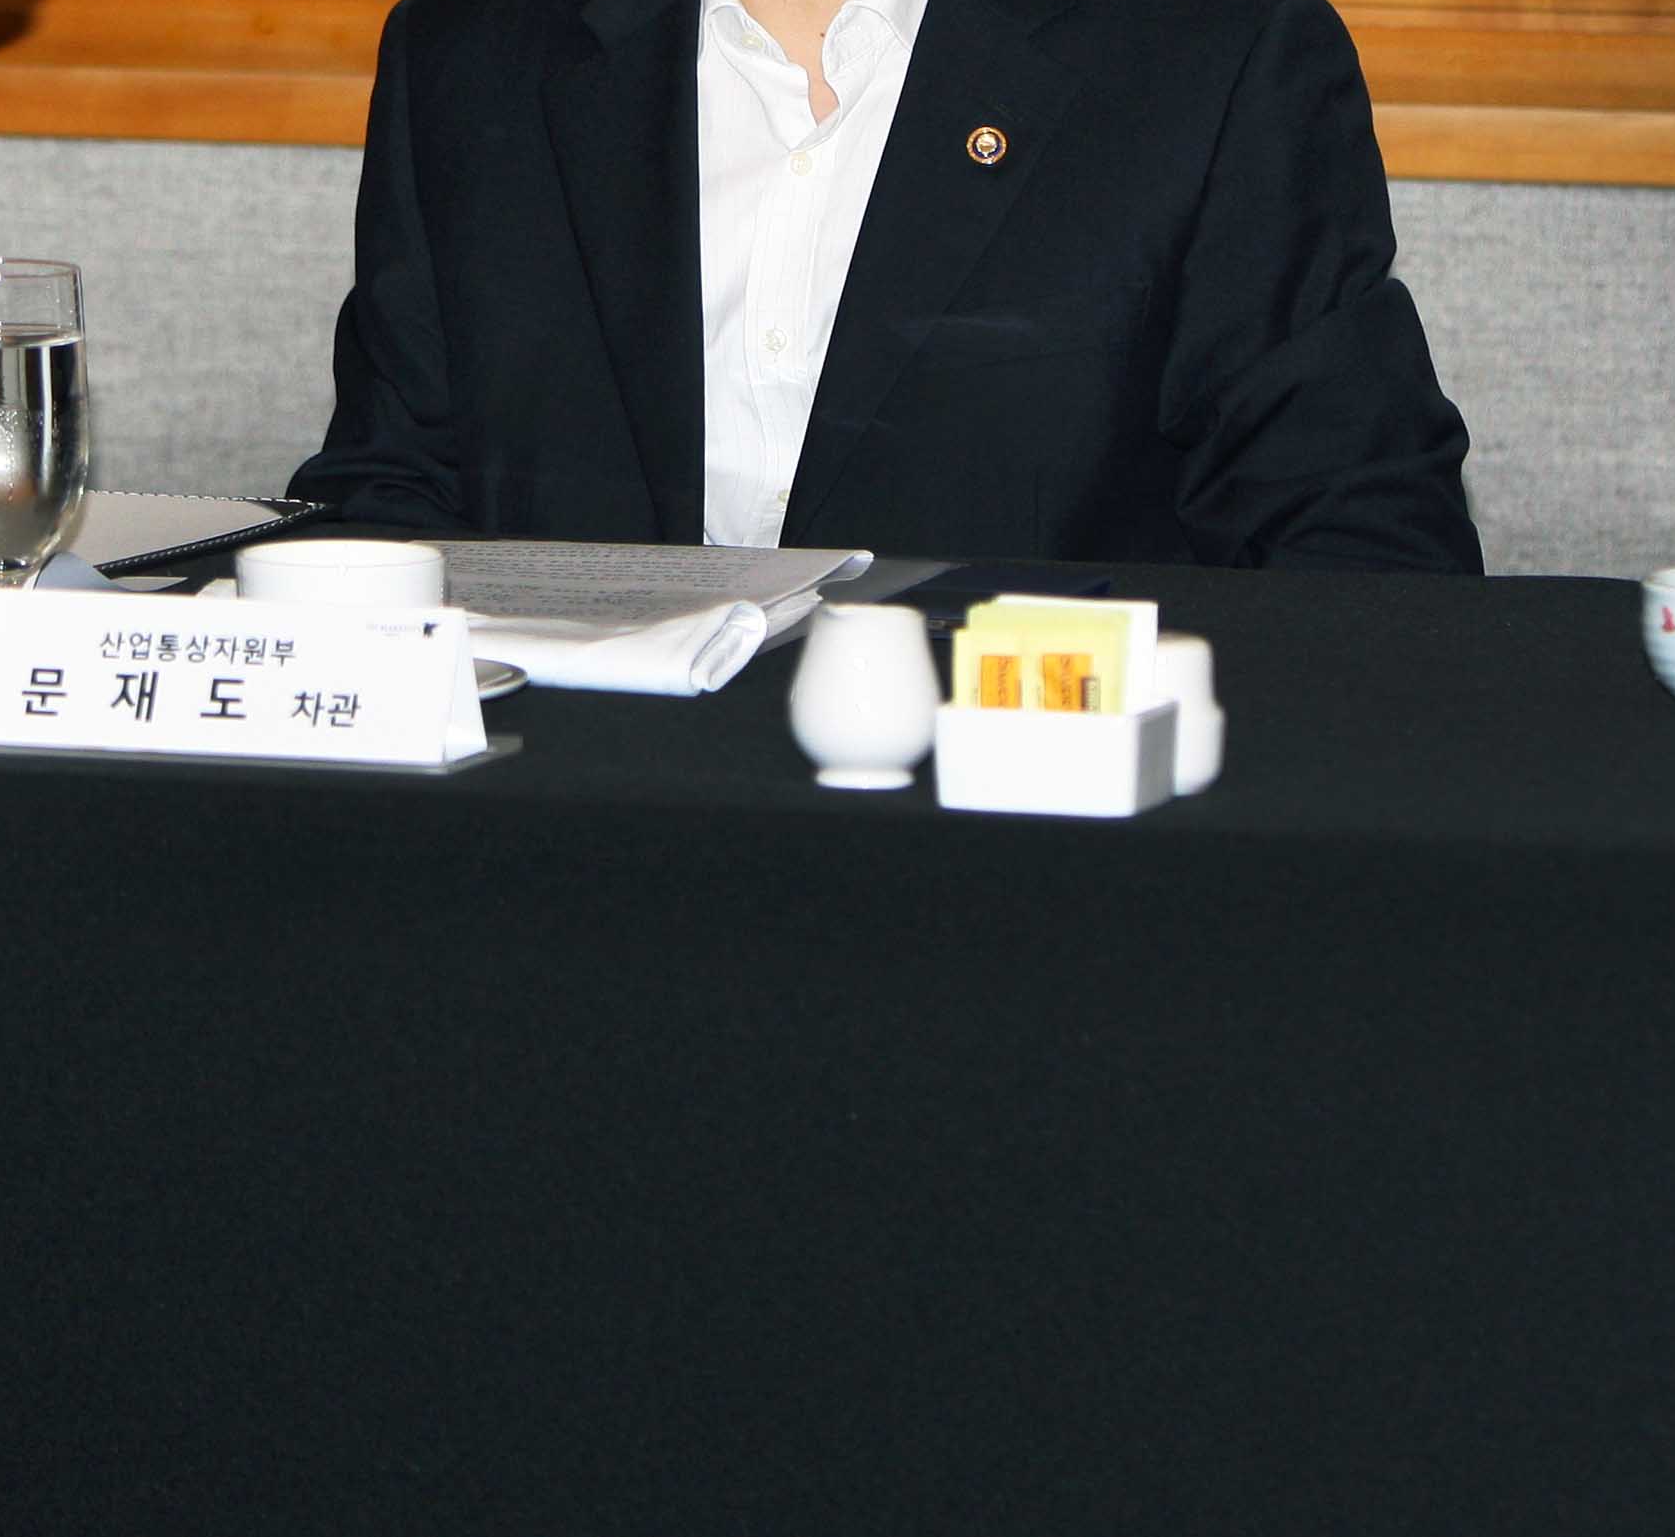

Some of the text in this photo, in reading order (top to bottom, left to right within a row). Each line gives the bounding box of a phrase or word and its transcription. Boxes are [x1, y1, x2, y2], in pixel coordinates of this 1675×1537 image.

[99, 631, 296, 666] 산업통상자원부
[21, 667, 361, 728] 문 재 도 차관
